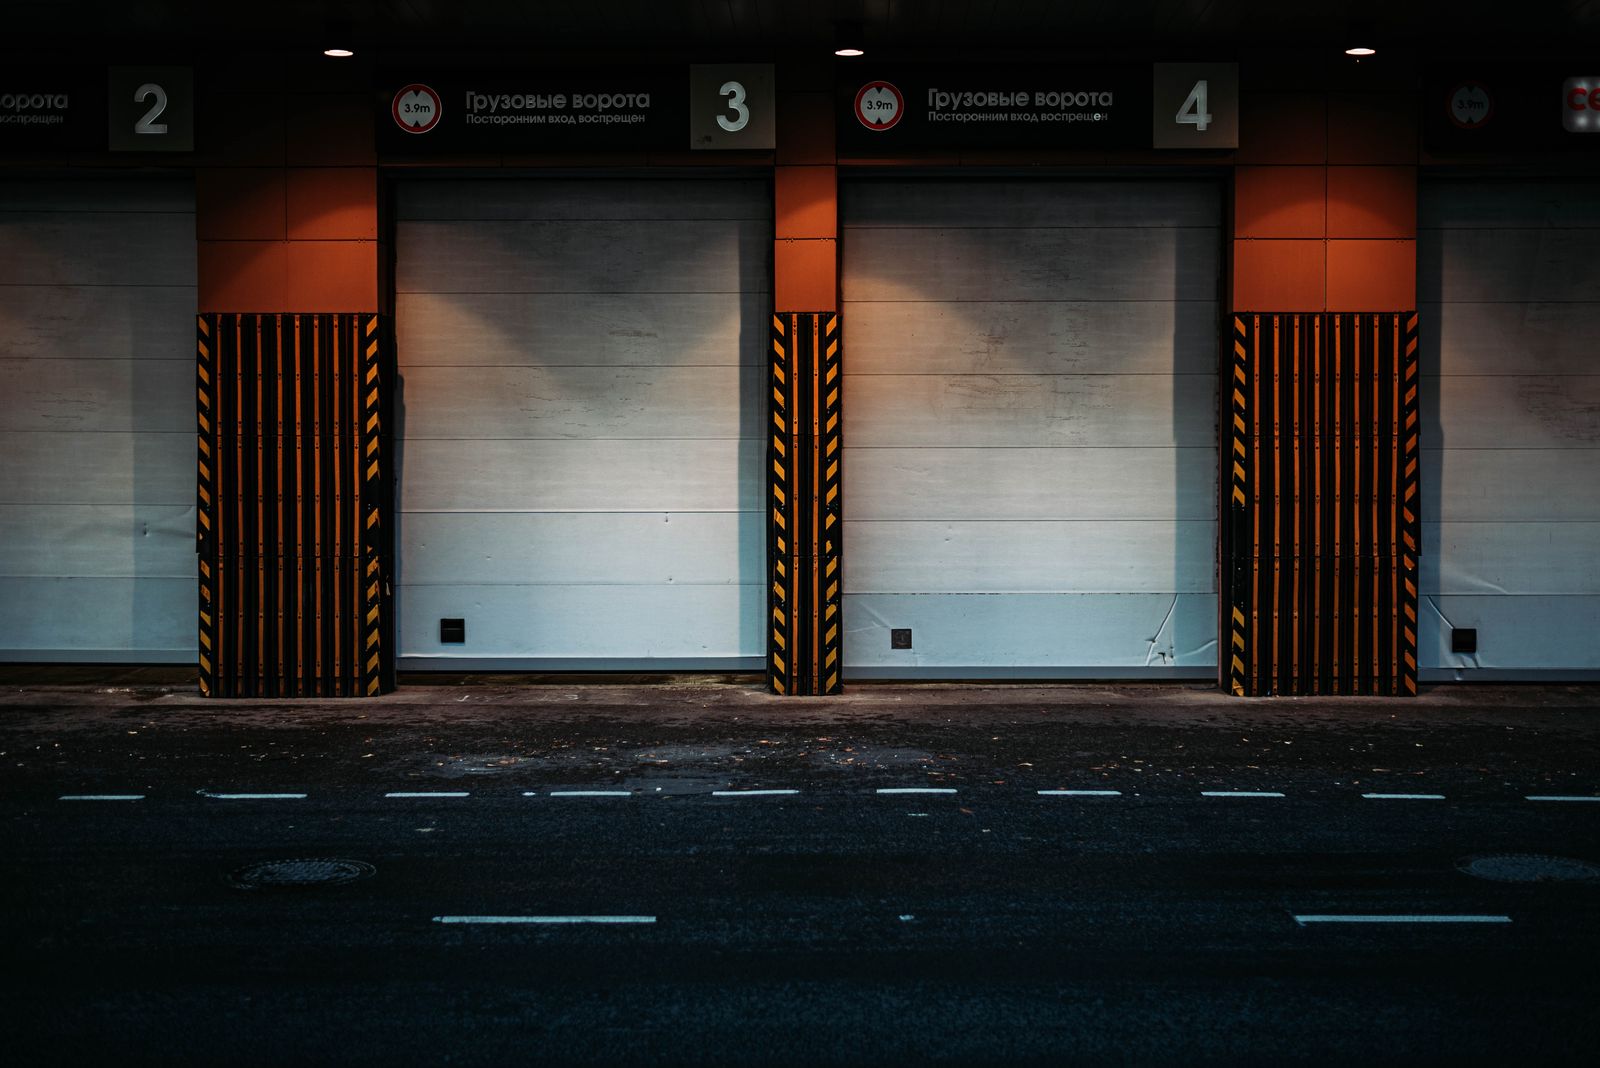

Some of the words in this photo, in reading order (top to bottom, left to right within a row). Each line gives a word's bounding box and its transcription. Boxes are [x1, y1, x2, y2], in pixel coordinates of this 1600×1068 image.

[0, 94, 68, 112] орота
[134, 82, 168, 134] 2
[465, 90, 566, 113] Грузовые
[572, 93, 650, 112] ворота
[716, 80, 750, 132] 3
[928, 88, 1030, 110] Грузовые
[1035, 91, 1113, 110] ворота
[1175, 79, 1213, 131] 4
[466, 113, 546, 126] Посторонним
[548, 115, 577, 125] вход
[578, 115, 646, 125] воспрещен
[928, 111, 1009, 123] Посторонним
[1010, 113, 1039, 123] вход
[1041, 113, 1108, 123] воспрещен
